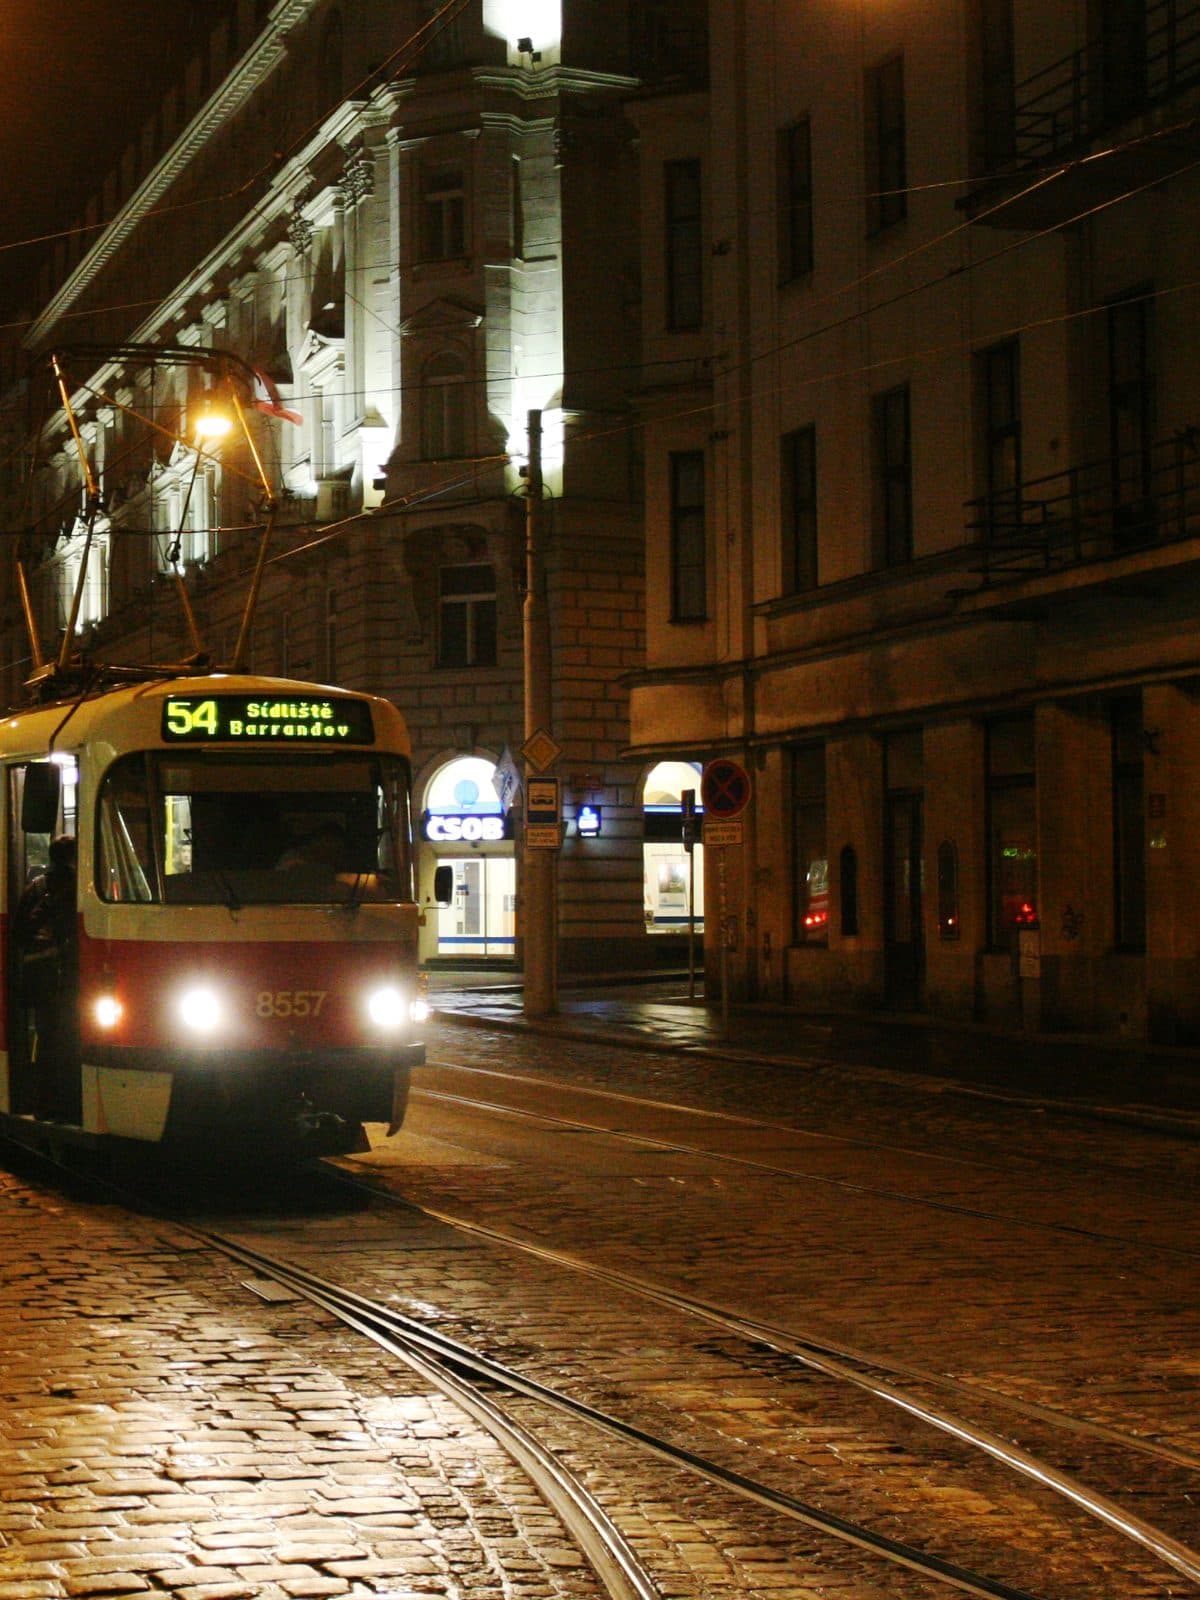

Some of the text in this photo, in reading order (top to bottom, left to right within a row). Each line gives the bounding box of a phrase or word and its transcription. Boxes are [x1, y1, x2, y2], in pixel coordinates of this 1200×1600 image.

[167, 701, 217, 735] 54
[246, 702, 334, 719] Sídliště
[229, 720, 349, 737] Barrandov
[426, 815, 505, 841] ČSOB
[256, 990, 329, 1017] 8557
